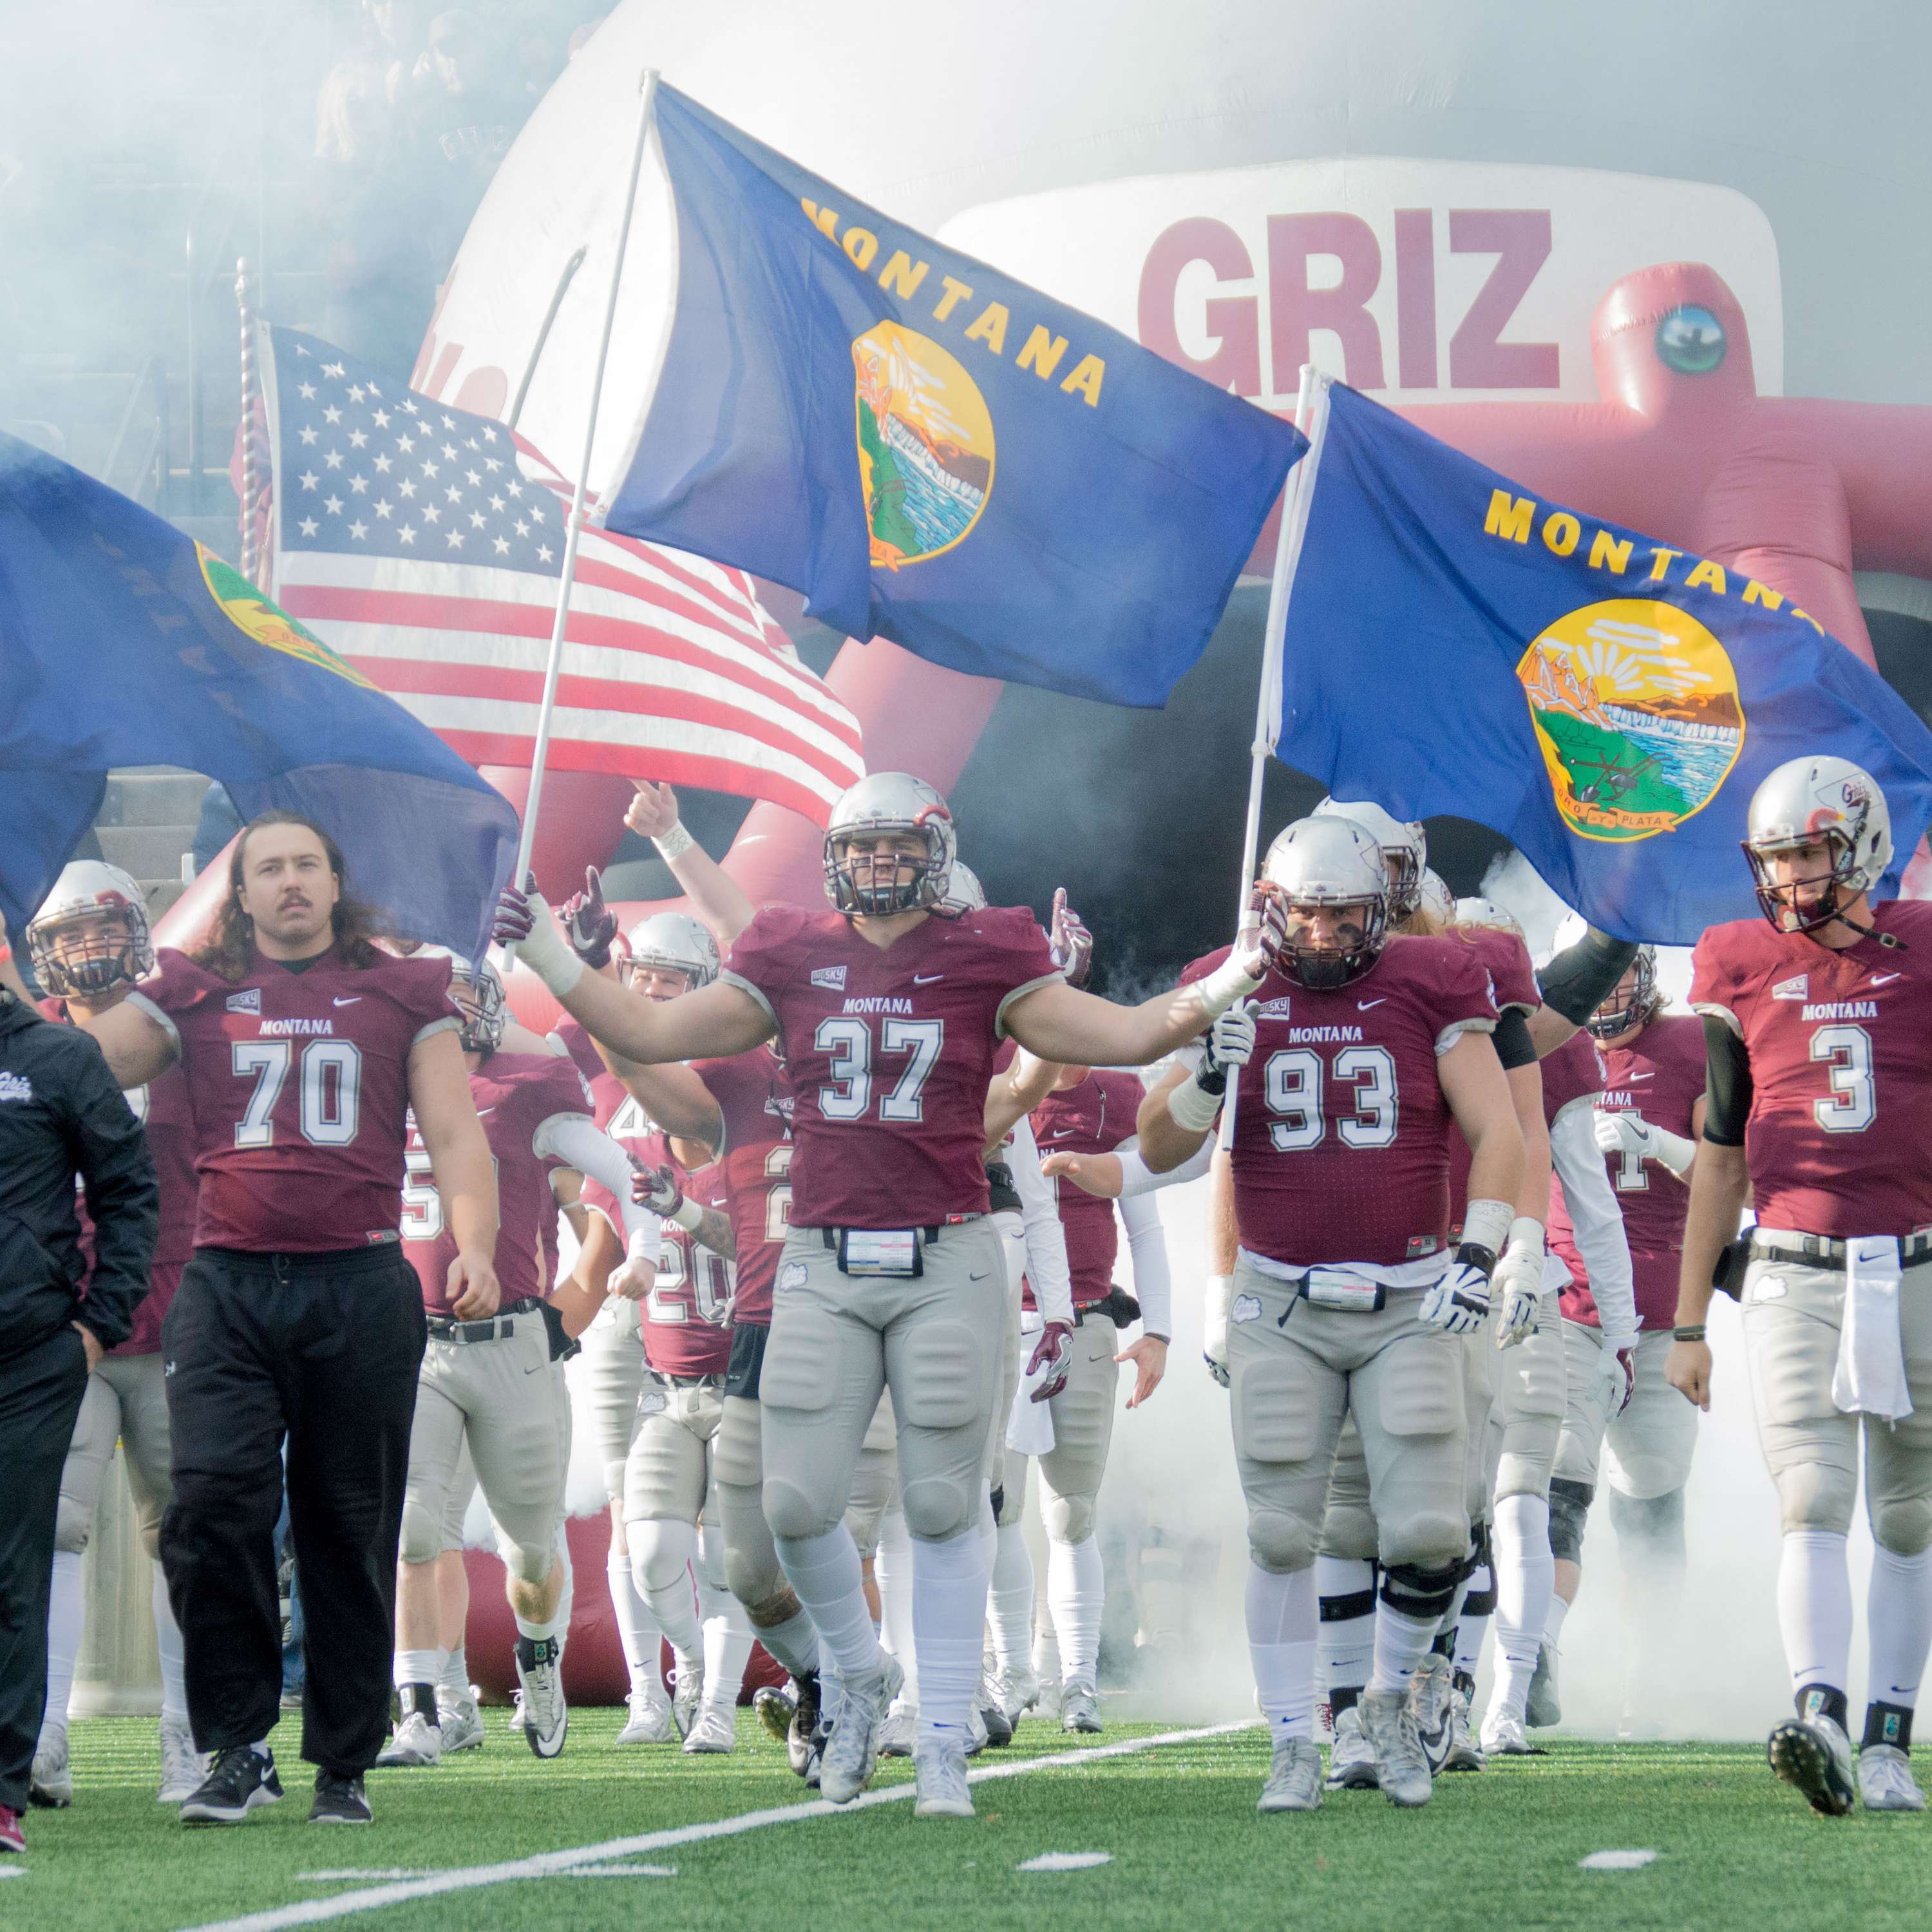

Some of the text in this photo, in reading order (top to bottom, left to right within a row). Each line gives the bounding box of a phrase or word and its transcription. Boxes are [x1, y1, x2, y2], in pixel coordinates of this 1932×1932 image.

[1137, 207, 1560, 397] GRIZ
[1484, 489, 1825, 637] MONTAN
[1621, 815, 1662, 826] PLATA
[258, 1019, 334, 1036] MONTANA
[842, 998, 913, 1014] MONTANA
[1289, 1026, 1363, 1044] MONTANA
[1801, 1001, 1879, 1021] MONTANA
[232, 1038, 362, 1147] 70
[814, 1017, 943, 1122] 37
[1264, 1046, 1399, 1152] 93
[1809, 1024, 1877, 1133] 3
[647, 1237, 737, 1324] 20
